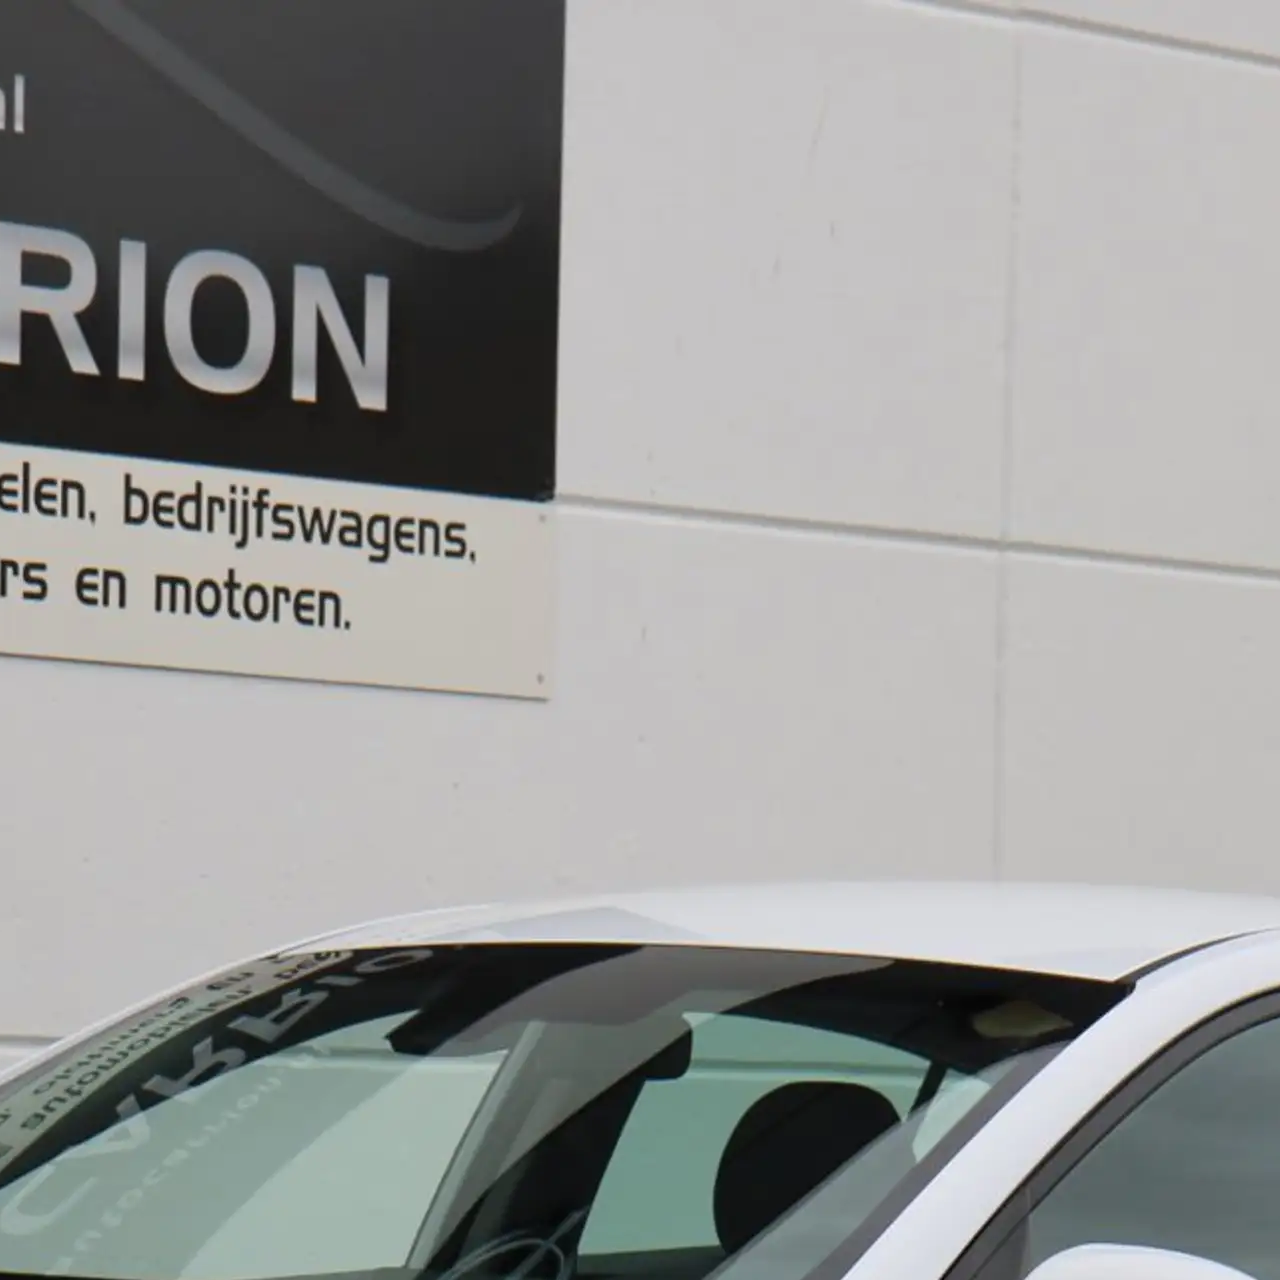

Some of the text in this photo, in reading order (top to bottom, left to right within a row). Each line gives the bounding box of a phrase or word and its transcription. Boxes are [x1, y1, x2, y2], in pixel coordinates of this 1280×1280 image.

[123, 472, 478, 565] bedrijfswagens,
[74, 565, 127, 610] en
[153, 572, 352, 631] motoren.
